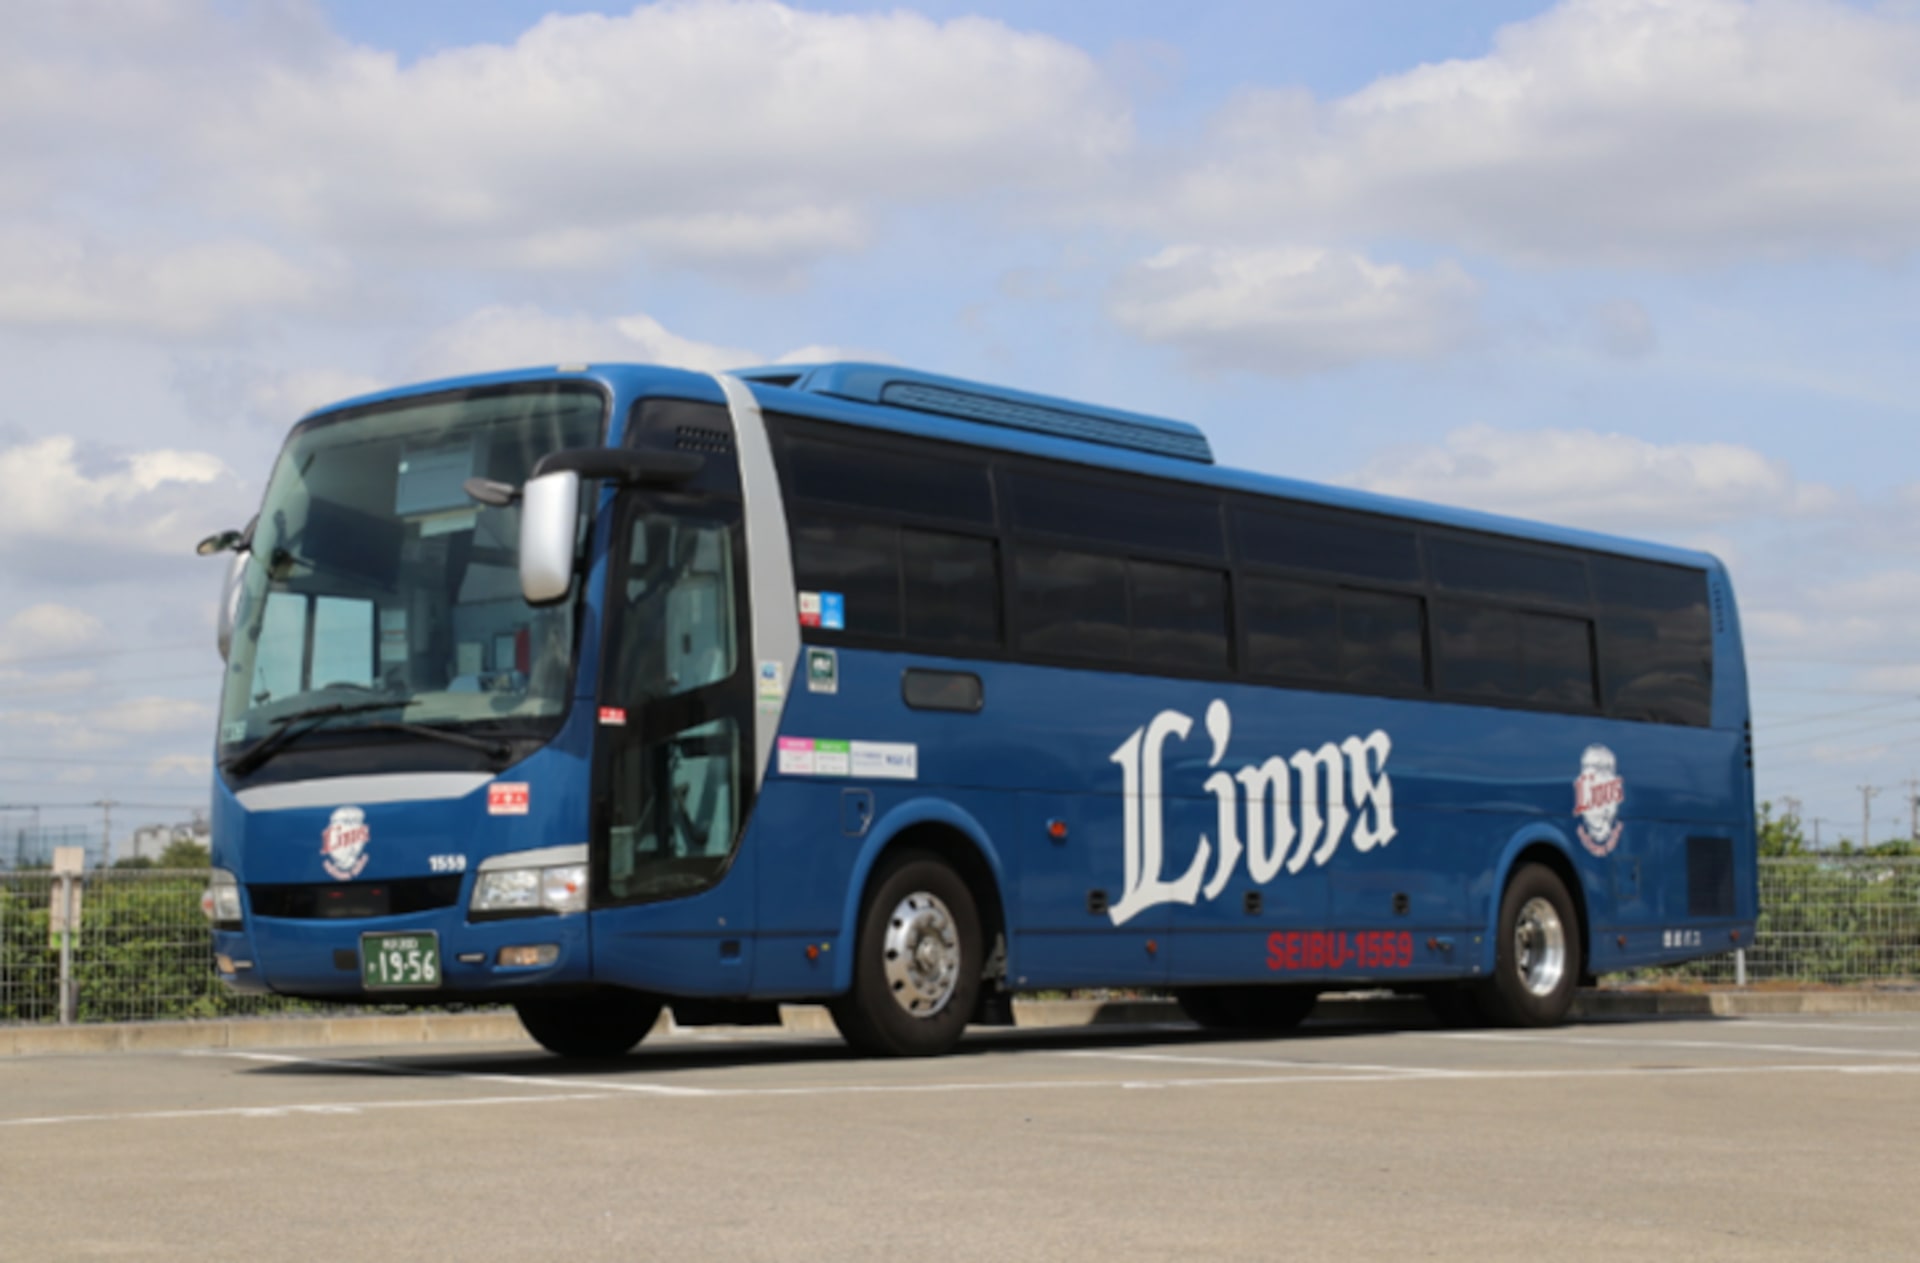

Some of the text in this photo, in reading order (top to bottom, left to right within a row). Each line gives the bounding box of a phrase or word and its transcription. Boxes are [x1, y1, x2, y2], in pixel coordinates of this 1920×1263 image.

[1108, 699, 1398, 927] Lions
[429, 855, 467, 872] 1559
[1266, 931, 1414, 971] SEIBU-1559
